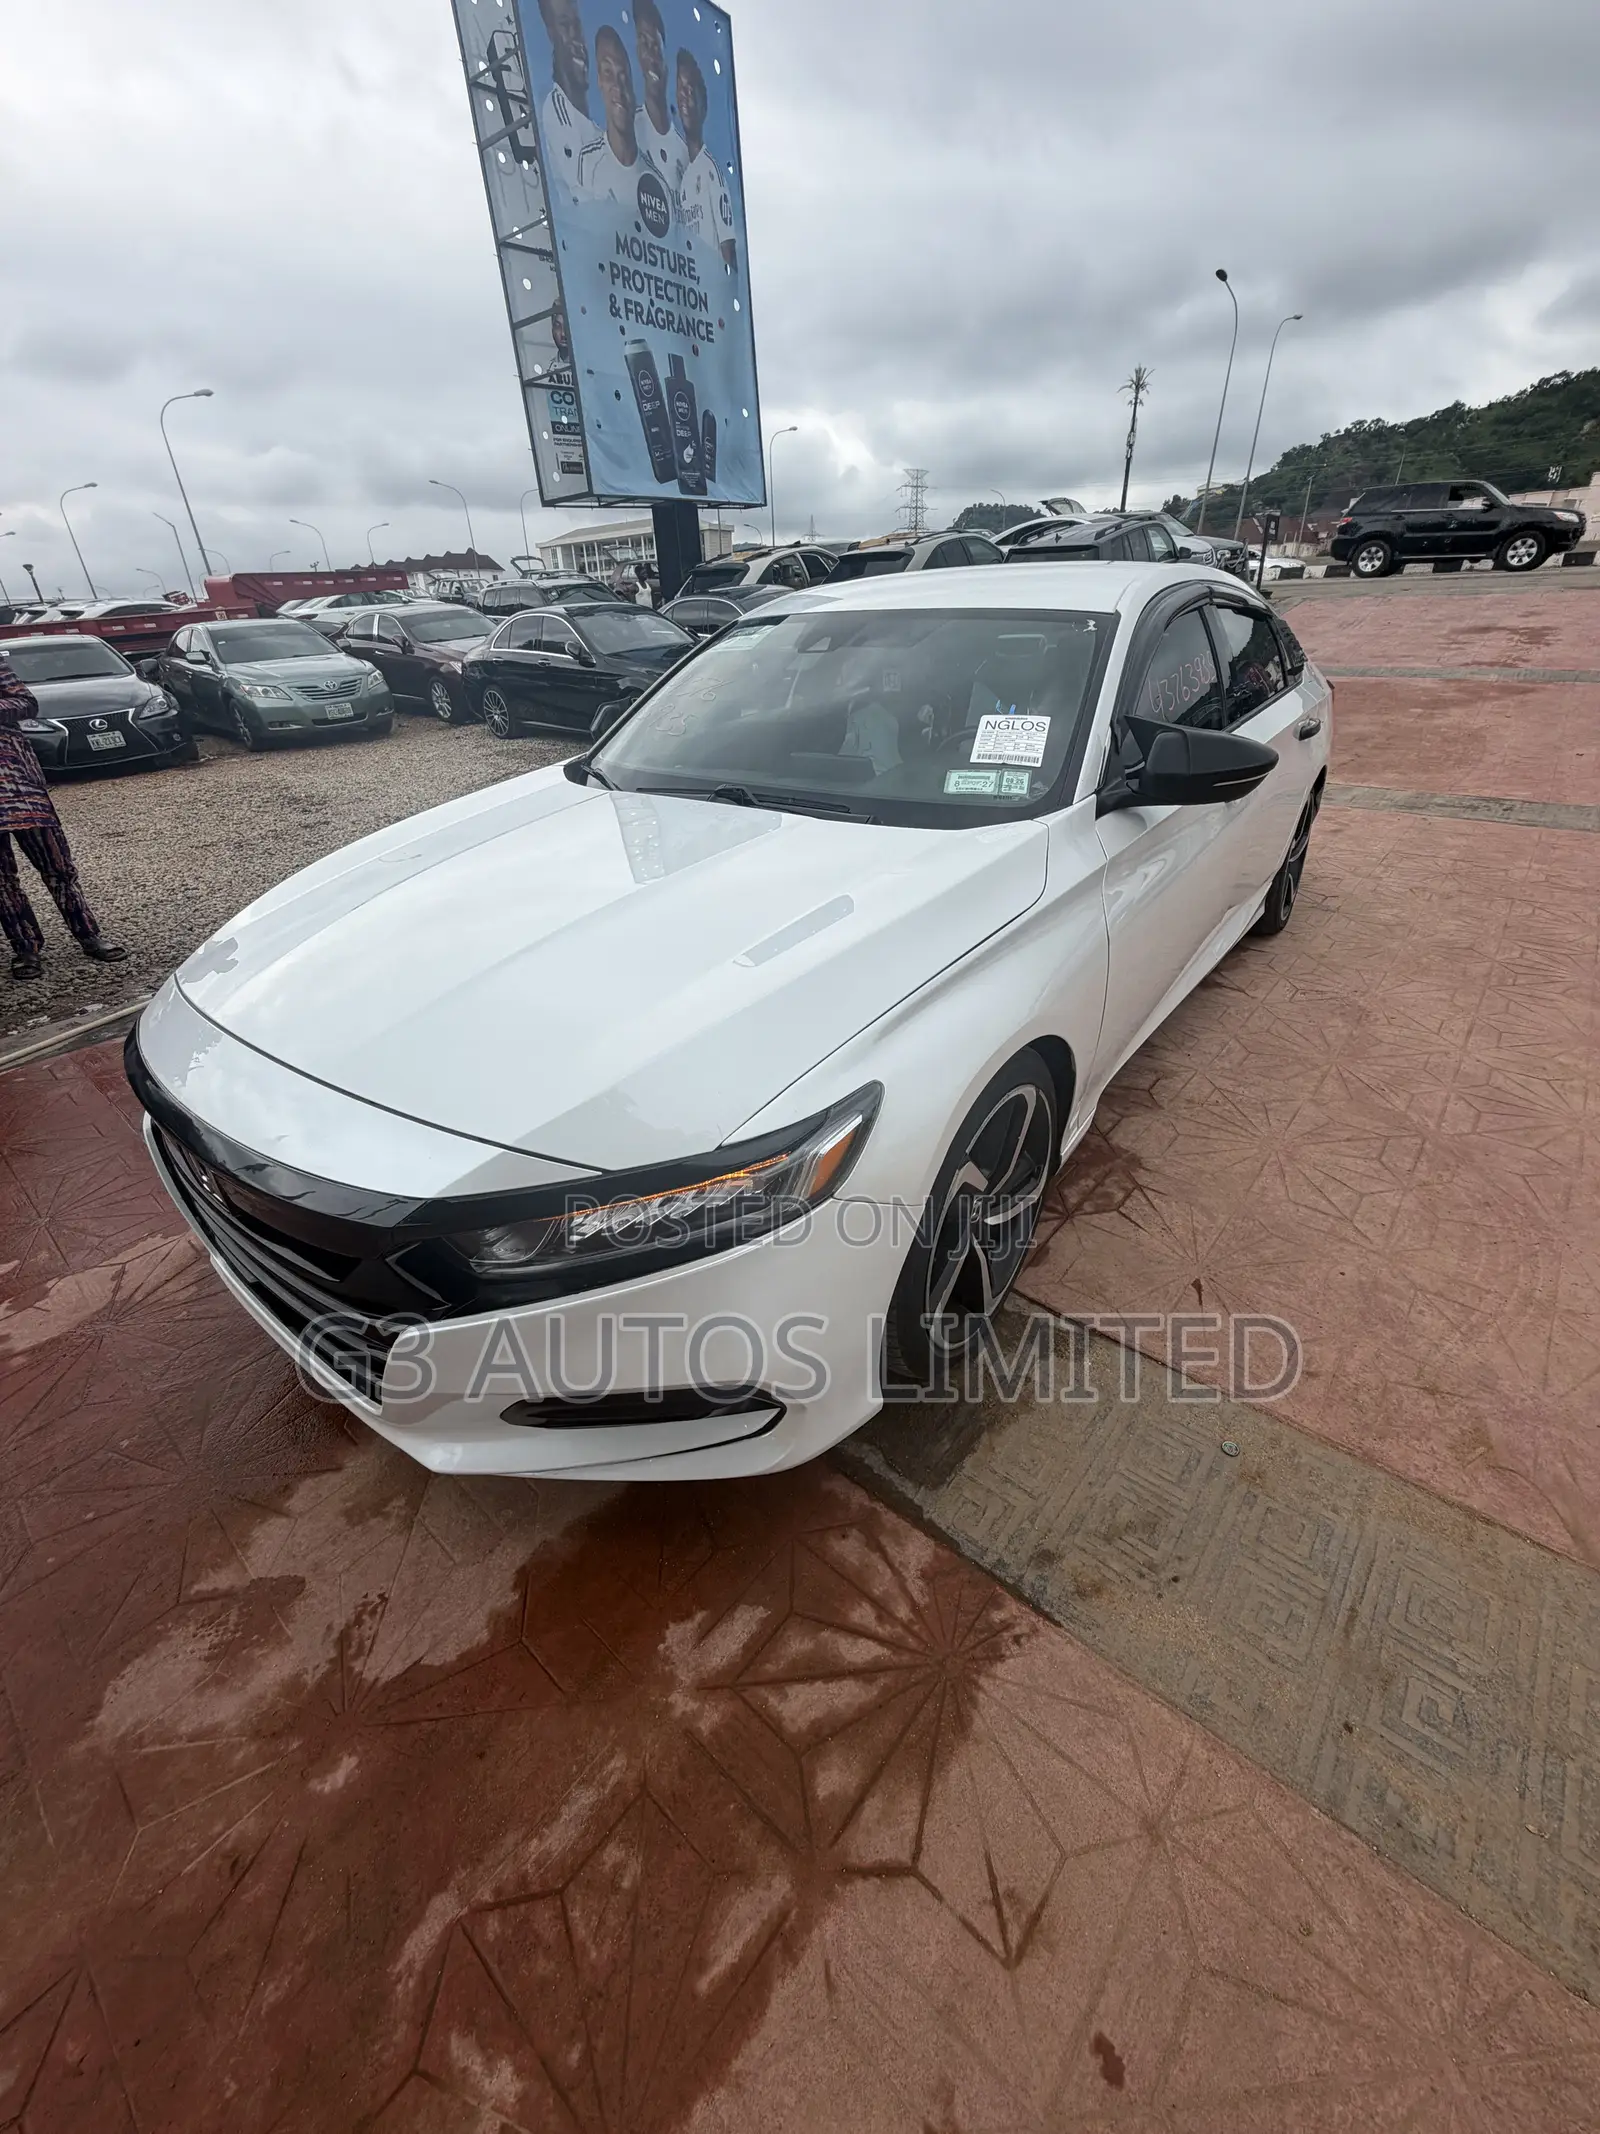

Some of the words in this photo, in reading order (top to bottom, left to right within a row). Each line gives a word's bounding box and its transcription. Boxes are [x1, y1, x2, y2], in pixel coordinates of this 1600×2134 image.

[640, 192, 668, 214] NIVEA
[645, 208, 665, 225] MEN
[615, 231, 701, 285] MOISTURE,
[609, 261, 709, 314] PROTECTION
[609, 292, 623, 320] &
[624, 297, 715, 344] FRAGRANCE
[642, 400, 661, 412] DEEP
[984, 720, 1047, 732] NGLOS
